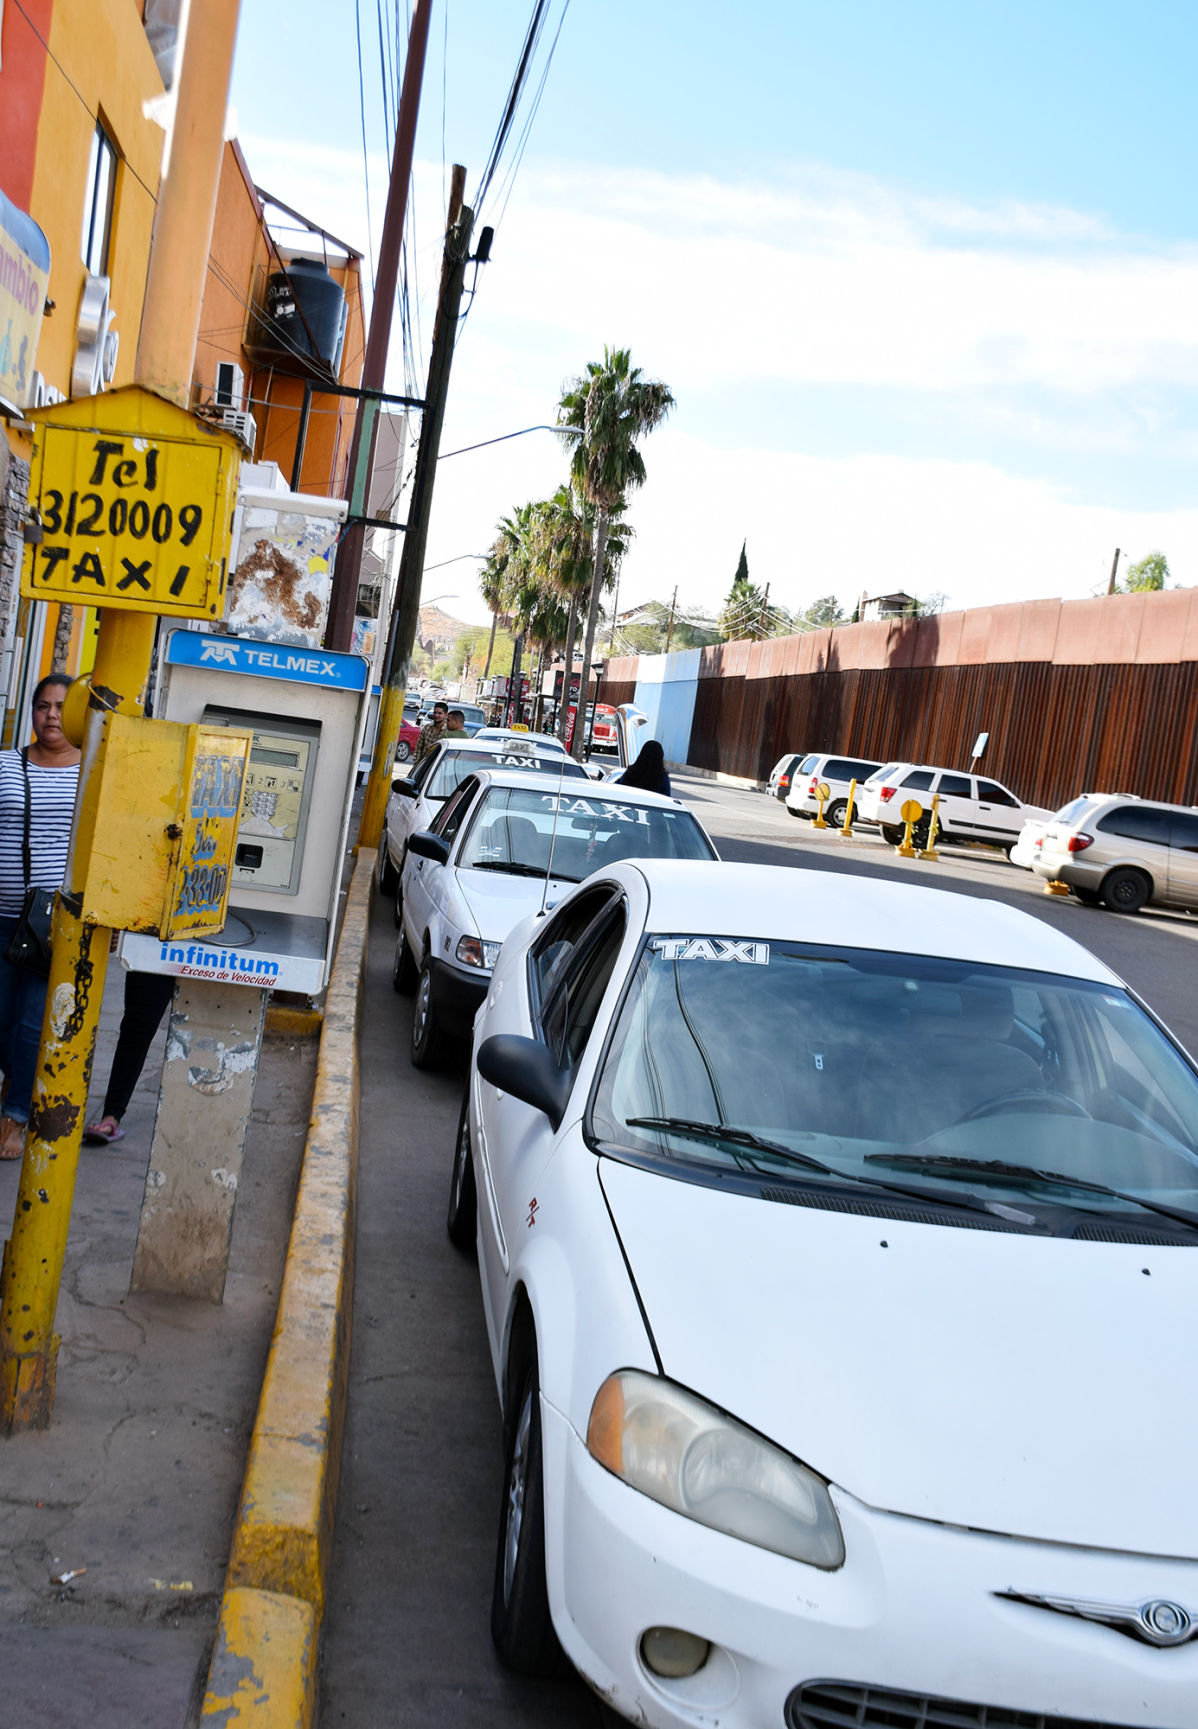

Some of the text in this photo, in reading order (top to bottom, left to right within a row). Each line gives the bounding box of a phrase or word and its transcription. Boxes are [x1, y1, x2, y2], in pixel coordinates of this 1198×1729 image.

[0, 244, 39, 316] mbio
[89, 440, 160, 492] Tel
[42, 489, 203, 547] 3120009
[41, 546, 191, 597] TAXI
[244, 649, 336, 677] TELMEX
[491, 754, 541, 769] TAXI
[541, 795, 651, 826] TAXI
[160, 943, 279, 976] infinitum
[653, 938, 770, 965] TAXI
[180, 965, 277, 987] Exceso de Velocidad
